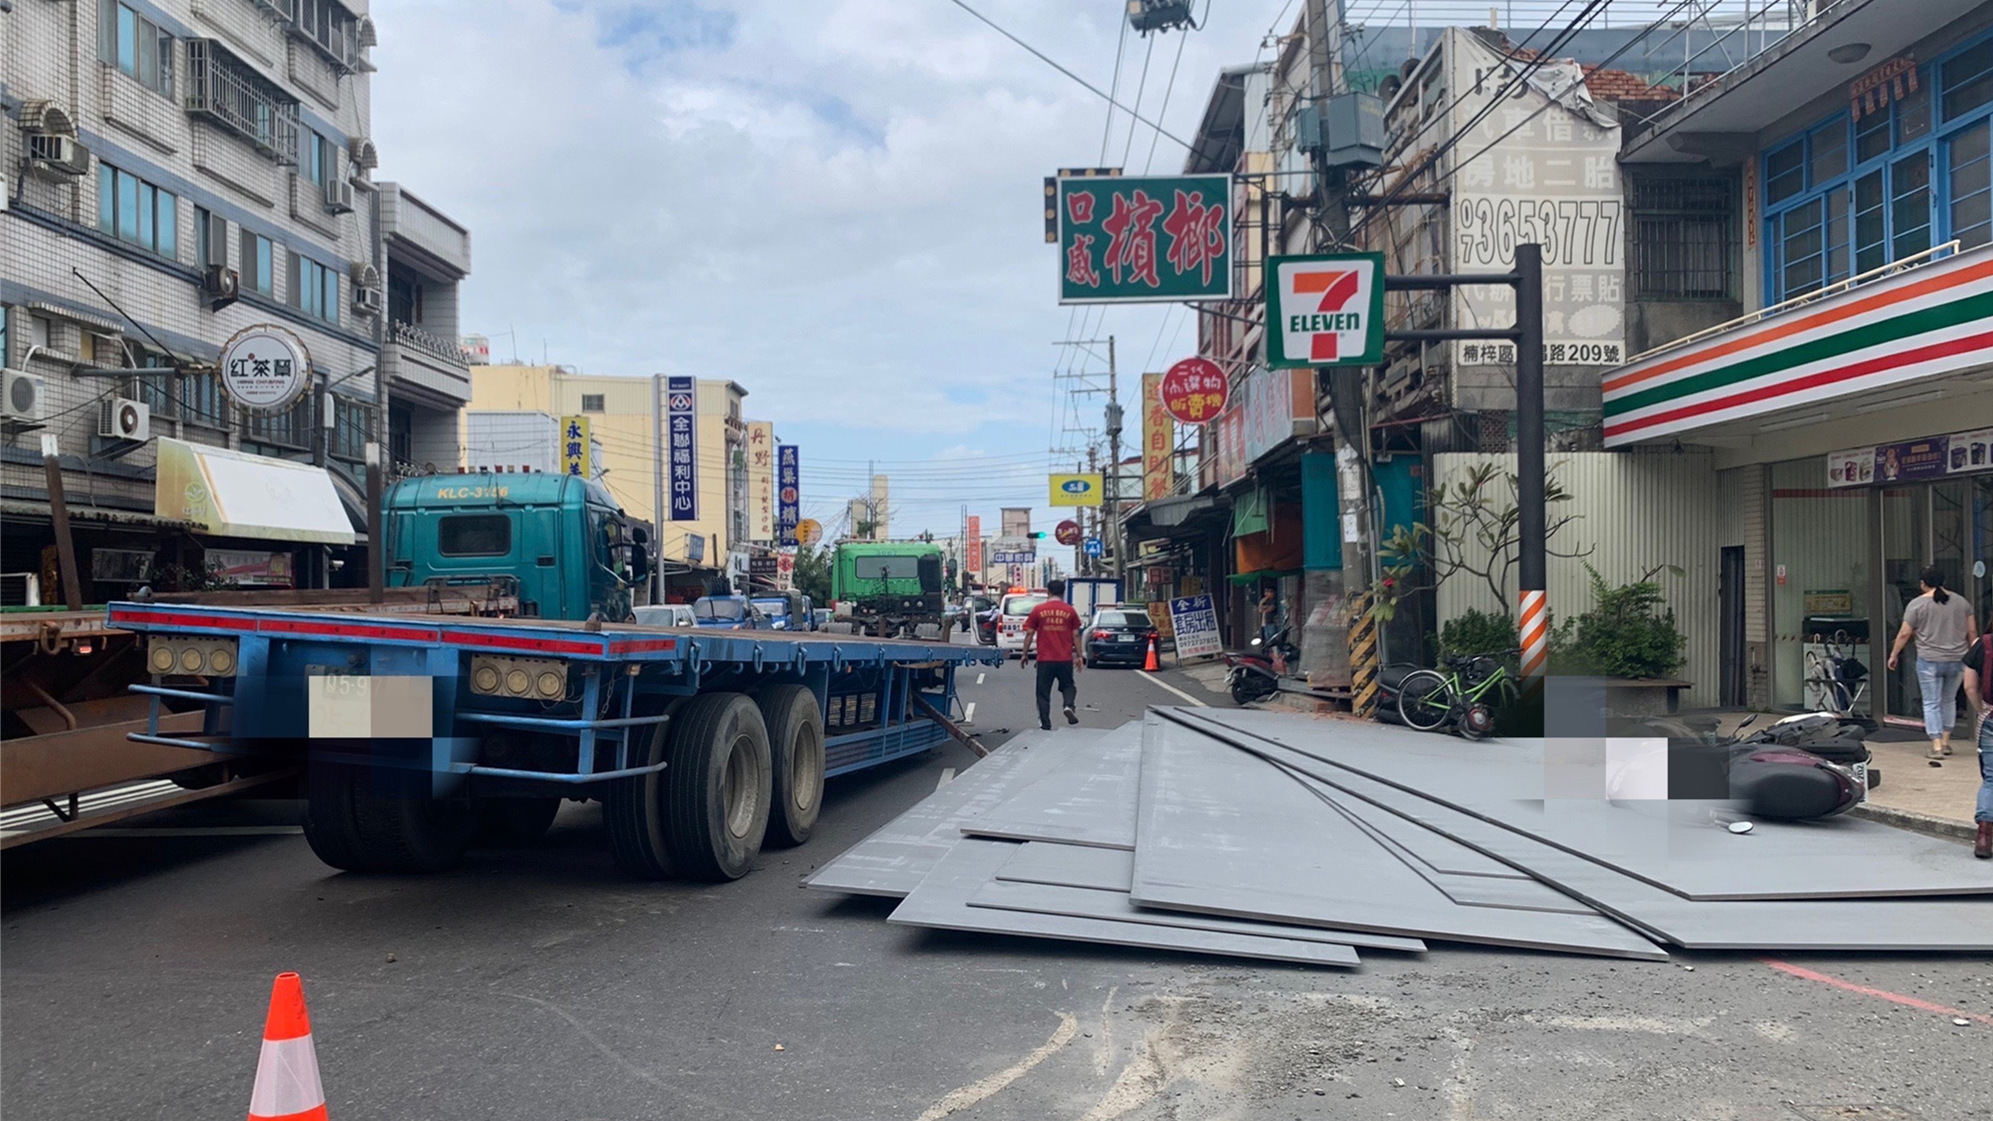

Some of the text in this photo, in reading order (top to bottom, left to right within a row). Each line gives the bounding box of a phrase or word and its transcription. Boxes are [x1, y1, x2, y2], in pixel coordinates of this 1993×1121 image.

[1464, 154, 1615, 189] 房地二胎
[1102, 189, 1225, 288] 檳榔
[673, 416, 692, 511] 全聯福利中心
[1174, 610, 1217, 636] 套房出租
